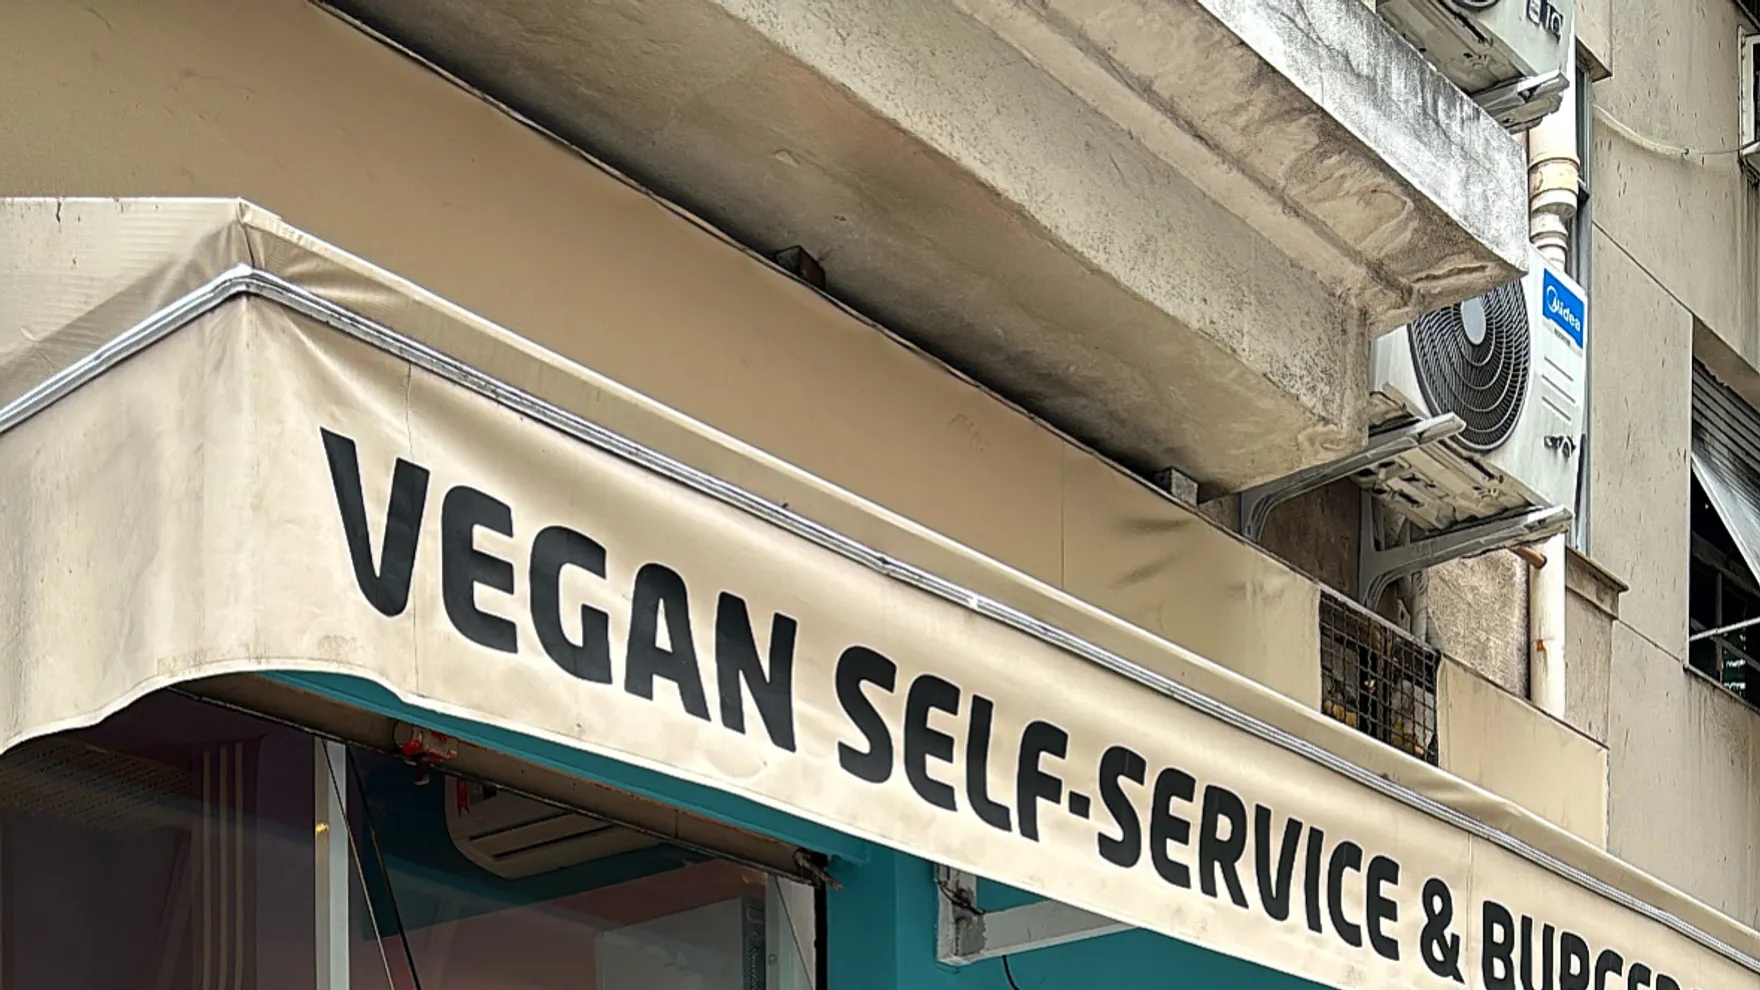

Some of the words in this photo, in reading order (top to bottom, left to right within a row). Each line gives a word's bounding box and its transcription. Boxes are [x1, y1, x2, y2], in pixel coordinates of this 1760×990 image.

[320, 427, 798, 753] VEGAN
[835, 645, 1400, 961] SELF-SERVICE
[1420, 878, 1465, 984] &
